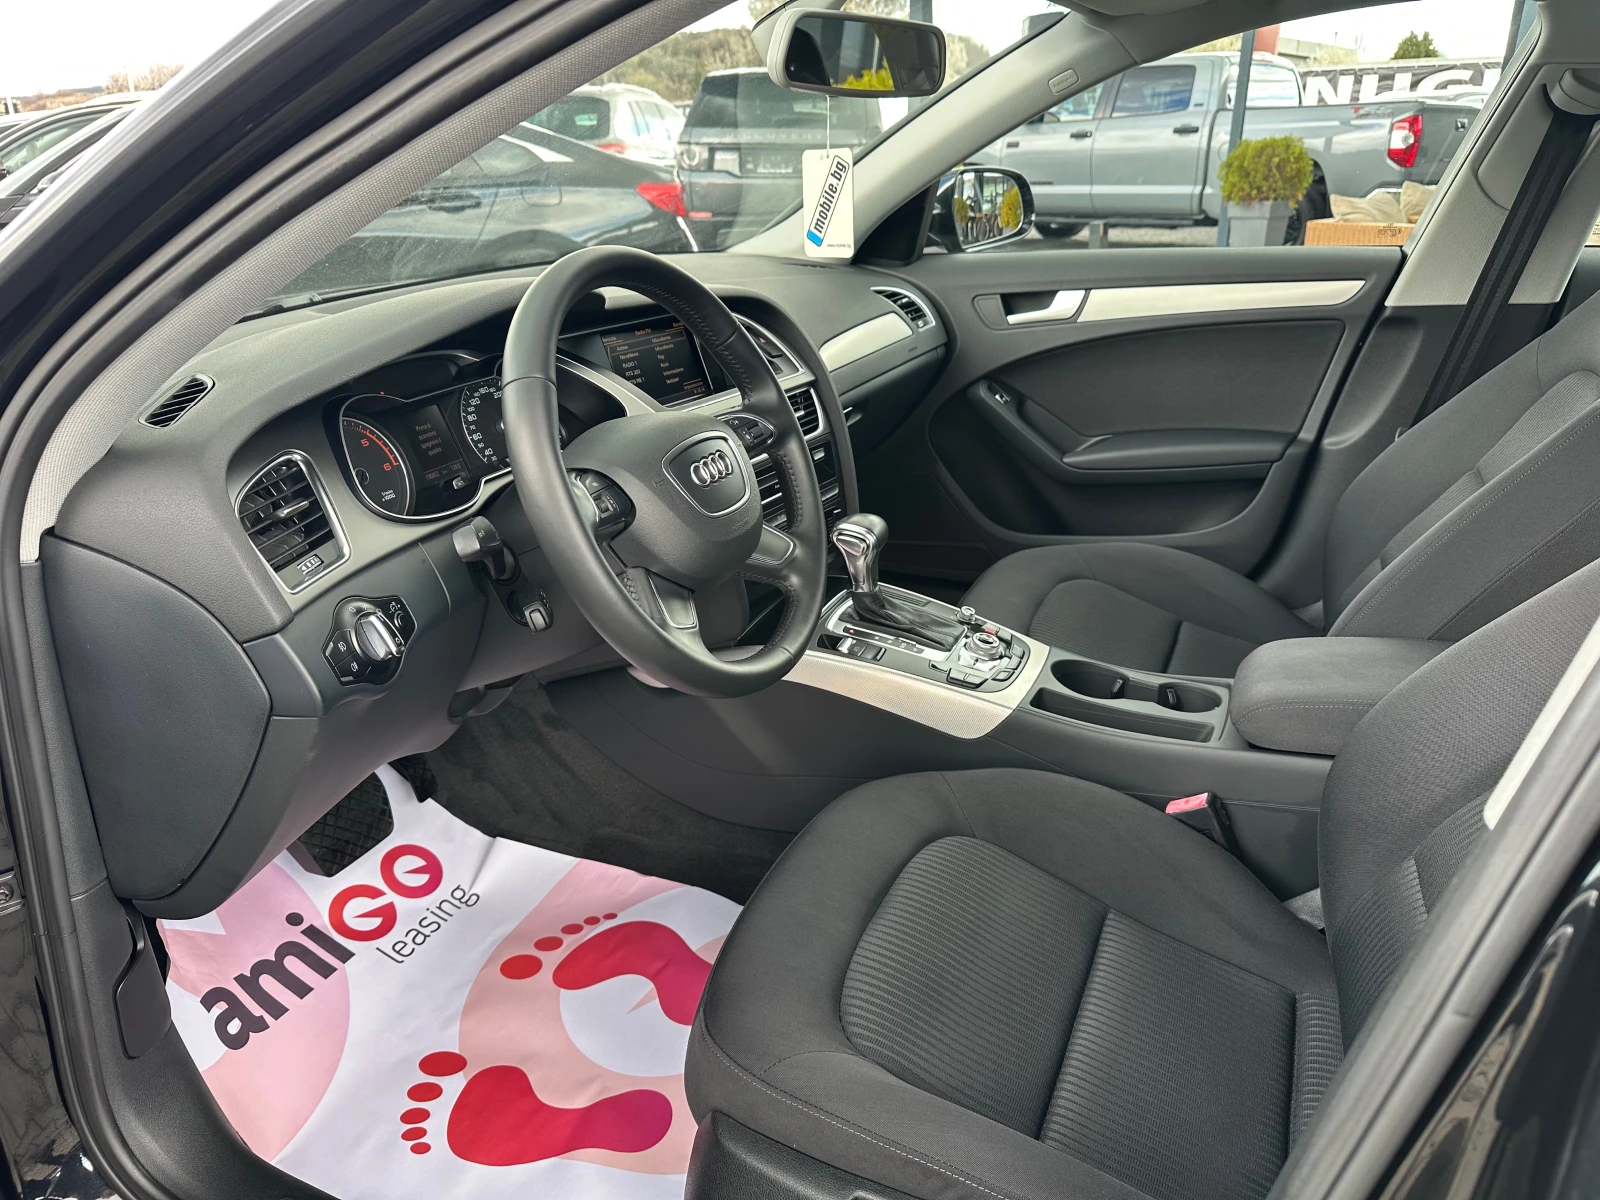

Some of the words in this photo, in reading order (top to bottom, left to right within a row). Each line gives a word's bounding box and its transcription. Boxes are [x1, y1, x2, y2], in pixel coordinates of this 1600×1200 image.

[813, 160, 847, 234] mobile.bg
[467, 413, 478, 421] 80
[473, 432, 483, 440] 60
[360, 439, 370, 447] 5
[484, 447, 494, 456] 40
[383, 462, 392, 471] 6
[375, 884, 480, 964] leasing
